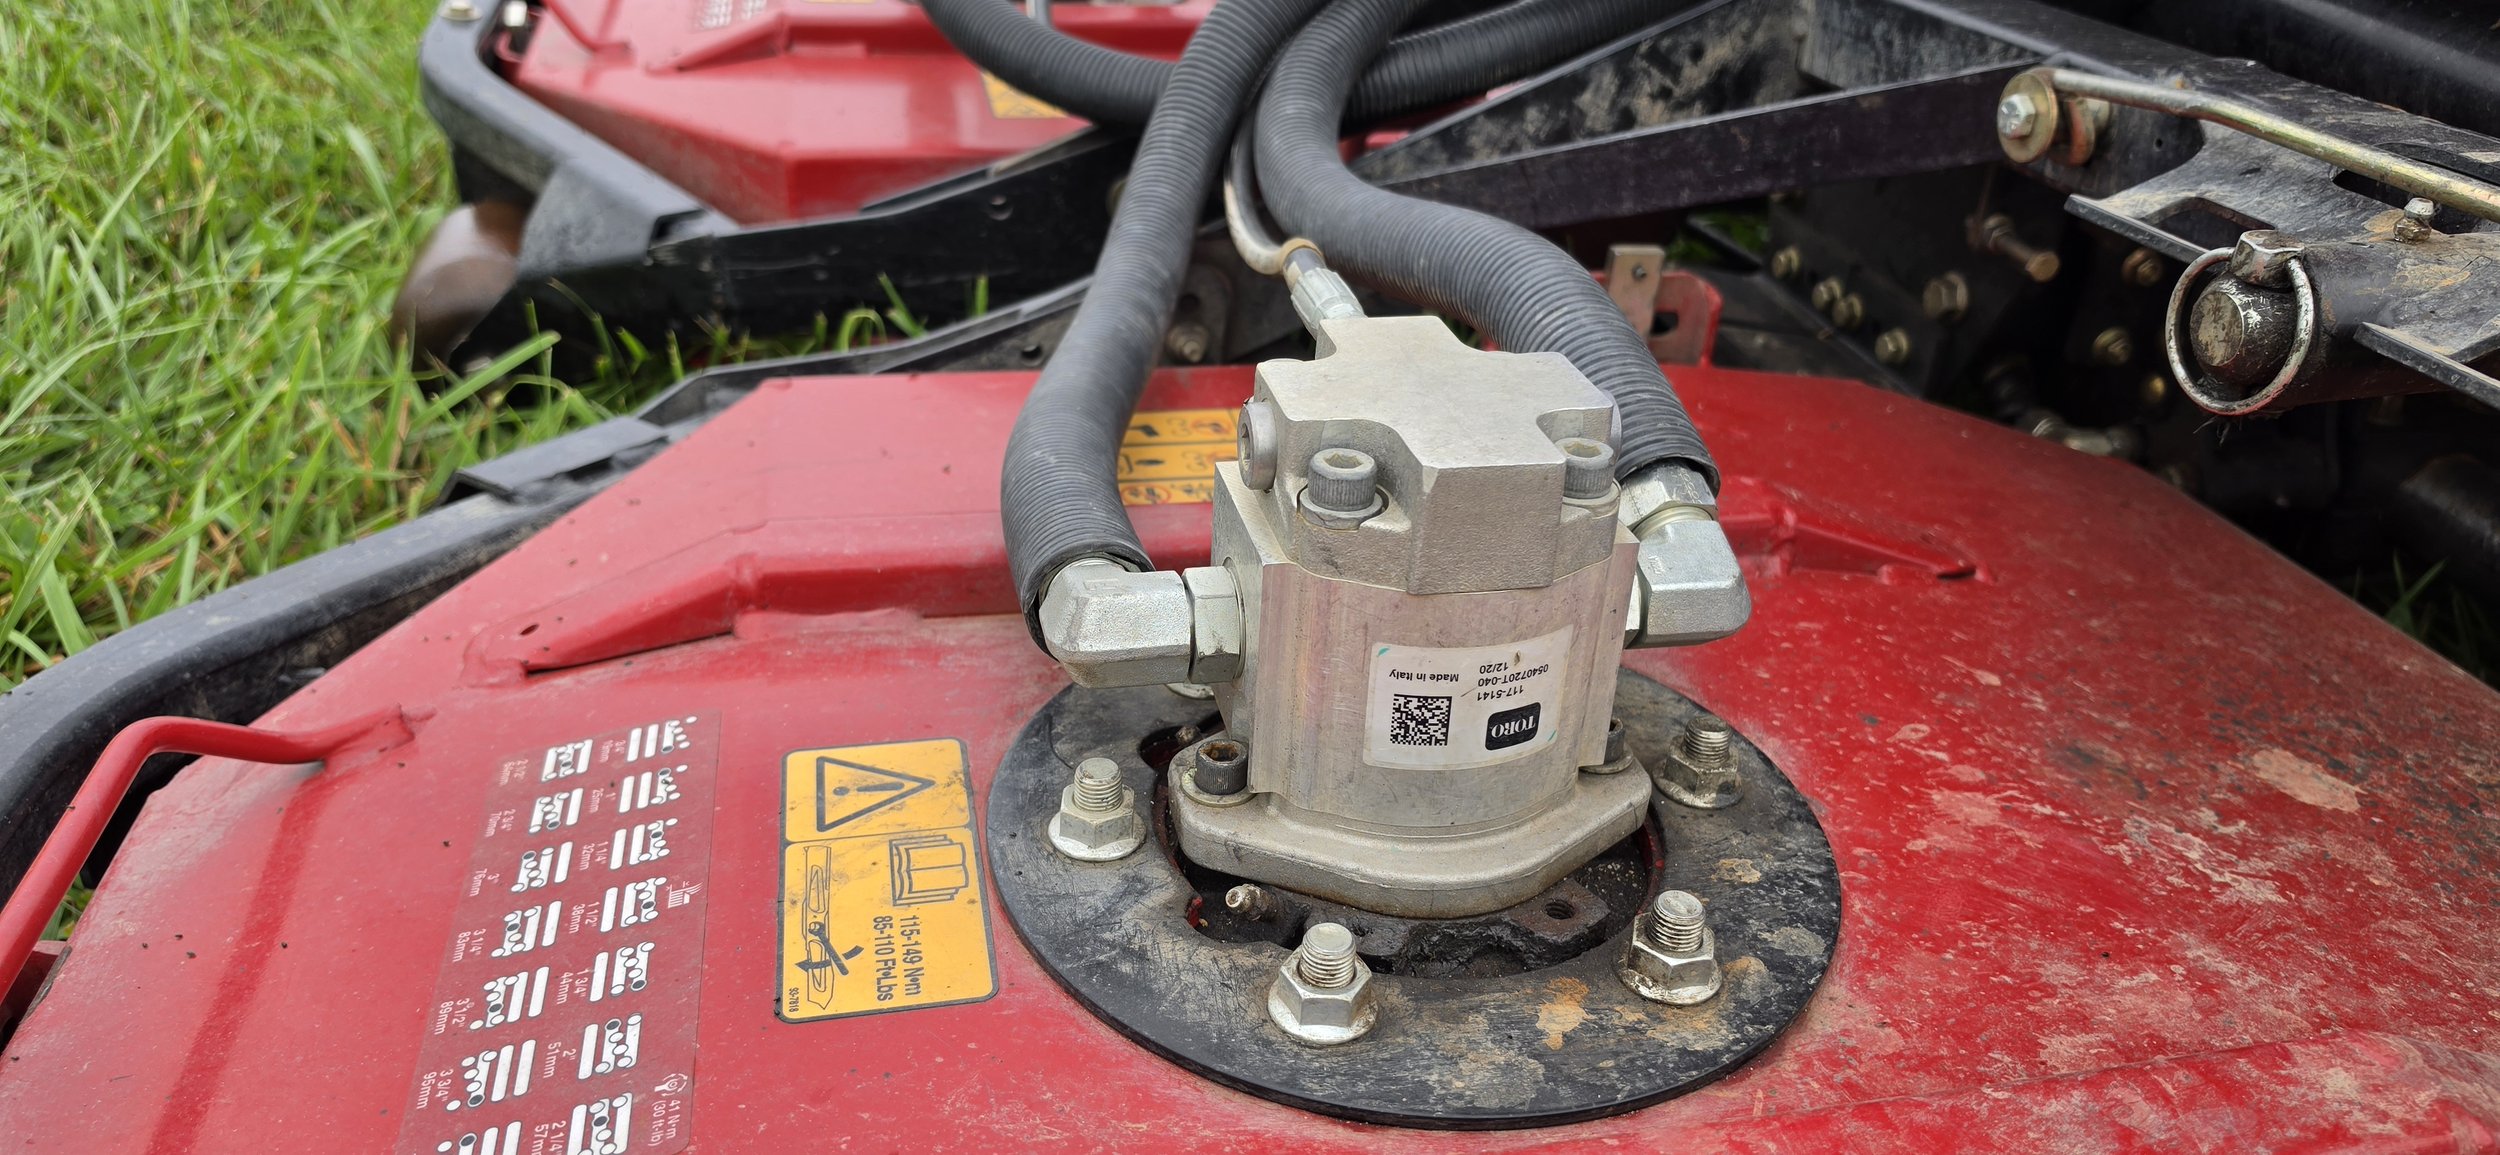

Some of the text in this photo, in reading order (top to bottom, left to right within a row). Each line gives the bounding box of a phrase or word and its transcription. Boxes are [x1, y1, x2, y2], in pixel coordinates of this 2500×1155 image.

[1389, 669, 1458, 682] Made in Italy
[1478, 664, 1548, 686] 0540720T-040
[1479, 662, 1508, 674] 12/20
[1477, 685, 1524, 700] 117-5141
[1491, 715, 1535, 738] TORO
[580, 843, 595, 870] 32mm
[469, 868, 487, 896] 76mm
[569, 904, 585, 934] 38mm
[585, 910, 598, 927] 1/2"
[469, 938, 484, 954] 1/4"
[873, 916, 895, 955] 85-110
[901, 915, 922, 964] 115-149
[452, 932, 471, 963] 83mm
[557, 972, 573, 1004] 44mm
[574, 978, 588, 997] 3/4"
[789, 988, 799, 1012] 93-7818
[434, 1001, 454, 1035] 89mm
[452, 1008, 468, 1027] 1/2"
[543, 1042, 561, 1078] 51mm
[563, 1049, 576, 1060] 2"
[416, 1072, 437, 1109] 95mm
[435, 1069, 454, 1102] 3 3/4"
[652, 1100, 666, 1117] (30
[669, 1100, 680, 1112] 41
[552, 1120, 566, 1129] 2
